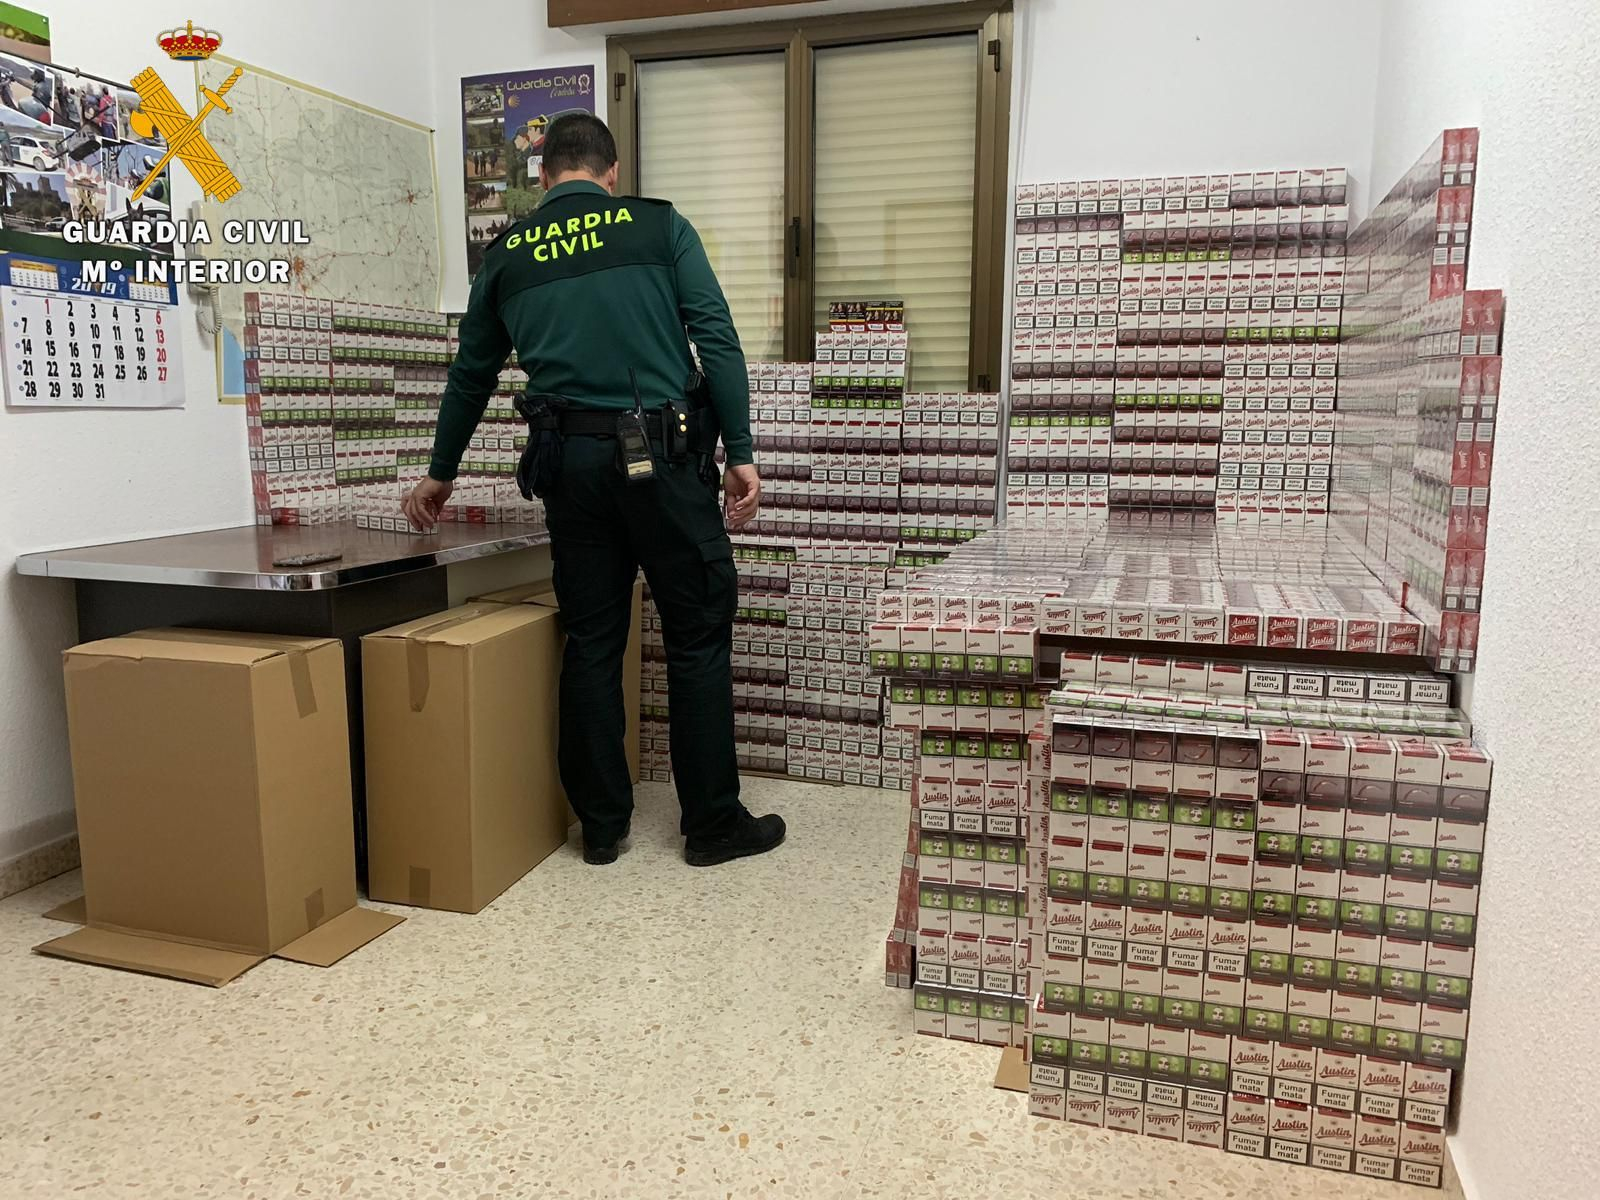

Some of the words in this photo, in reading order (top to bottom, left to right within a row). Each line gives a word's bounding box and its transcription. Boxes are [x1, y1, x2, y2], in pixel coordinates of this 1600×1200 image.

[506, 78, 552, 91] Guardia
[554, 75, 576, 87] Civil
[505, 207, 633, 250] GUARDIA
[533, 231, 604, 263] CIVIL
[44, 299, 50, 314] 1
[67, 301, 73, 317] 2
[90, 303, 96, 319] 3
[113, 306, 118, 320] 4
[135, 308, 140, 323] 5
[156, 310, 161, 325] 6
[21, 317, 27, 333] 7
[46, 319, 52, 336] 8
[69, 322, 75, 337] 9
[90, 324, 100, 339] 10
[113, 326, 121, 341] 11
[135, 328, 144, 343] 12
[156, 329, 164, 344] 13
[22, 339, 32, 355] 14
[45, 340, 56, 356] 15
[69, 342, 79, 358] 16
[92, 344, 101, 359] 17
[114, 345, 124, 360] 18
[136, 347, 145, 361] 19
[156, 349, 166, 363] 20
[22, 360, 33, 376] 21
[47, 361, 59, 377] 22
[70, 363, 82, 378] 23
[93, 363, 104, 379] 24
[115, 365, 126, 380] 25
[137, 366, 147, 380] 26
[158, 367, 167, 381] 27
[24, 381, 37, 397] 28
[49, 382, 61, 397] 29
[72, 383, 83, 398] 30
[95, 383, 105, 399] 31
[921, 792, 949, 804] Austin
[954, 795, 982, 806] Austin
[987, 797, 1016, 809] Austin
[924, 813, 946, 821] Fumar
[957, 816, 979, 824] Fumar
[993, 825, 1010, 833] mata
[1049, 913, 1083, 926] Austin
[1088, 918, 1123, 930] Austin
[1129, 923, 1164, 936] Austin
[1169, 927, 1204, 940] Austin
[1052, 936, 1078, 946] Fumar
[1210, 932, 1246, 945] Austin
[919, 945, 946, 957] Austin
[1055, 944, 1075, 953] mata
[1091, 942, 1117, 951] Fumar
[1131, 946, 1158, 956] Fumar
[951, 950, 979, 961] Austin
[1094, 949, 1115, 958] mata
[1134, 954, 1154, 962] mata
[1172, 951, 1198, 961] Fumar
[984, 954, 1012, 965] Austin
[1174, 958, 1195, 967] mata
[1213, 955, 1241, 966] Fumar
[922, 966, 943, 975] Fumar
[1216, 963, 1236, 972] mata
[924, 973, 941, 981] mata
[954, 971, 975, 979] Fumar
[987, 975, 1008, 983] Fumar
[956, 977, 973, 985] mata
[1234, 1052, 1270, 1065] Austin
[1276, 1058, 1313, 1071] Austin
[1038, 1067, 1058, 1075] mata
[1319, 1065, 1356, 1078] Austin
[1035, 1073, 1061, 1084] Fumar
[1076, 1073, 1096, 1082] mata
[1236, 1075, 1264, 1086] Fumar
[1363, 1072, 1401, 1087] Austin
[1073, 1080, 1099, 1090] Fumar
[1115, 1080, 1135, 1088] mata
[1239, 1084, 1261, 1093] mata
[1278, 1082, 1307, 1093] Fumar
[1408, 1079, 1447, 1093] Austin
[1111, 1086, 1138, 1096] Fumar
[1155, 1087, 1175, 1095] mata
[1281, 1091, 1303, 1100] mata
[1322, 1089, 1350, 1100] Fumar
[1031, 1094, 1063, 1105] Austin
[1151, 1093, 1178, 1103] Fumar
[1195, 1093, 1216, 1102] mata
[1324, 1098, 1346, 1107] mata
[1365, 1097, 1395, 1108] Fumar
[1069, 1100, 1101, 1113] Austin
[1192, 1099, 1219, 1110] Fumar
[1368, 1105, 1391, 1115] mata
[1410, 1104, 1440, 1115] Fumar
[1106, 1106, 1141, 1119] Austin
[1413, 1113, 1436, 1123] mata
[1146, 1113, 1181, 1127] Austin
[1230, 1112, 1266, 1126] Austin
[1186, 1120, 1221, 1133] Austin
[1272, 1118, 1308, 1132] Austin
[1315, 1126, 1352, 1139] Austin
[1232, 1135, 1260, 1146] Fumar
[1358, 1132, 1396, 1147] Austin
[1235, 1143, 1256, 1153] mata
[1274, 1142, 1302, 1153] Fumar
[1403, 1139, 1442, 1154] Austin
[1277, 1151, 1299, 1160] mata
[1317, 1149, 1346, 1160] Fumar
[1320, 1158, 1342, 1168] mata
[1361, 1157, 1390, 1168] Fumar
[1363, 1166, 1386, 1175] mata
[1405, 1165, 1435, 1176] Fumar
[1408, 1174, 1431, 1183] mata
